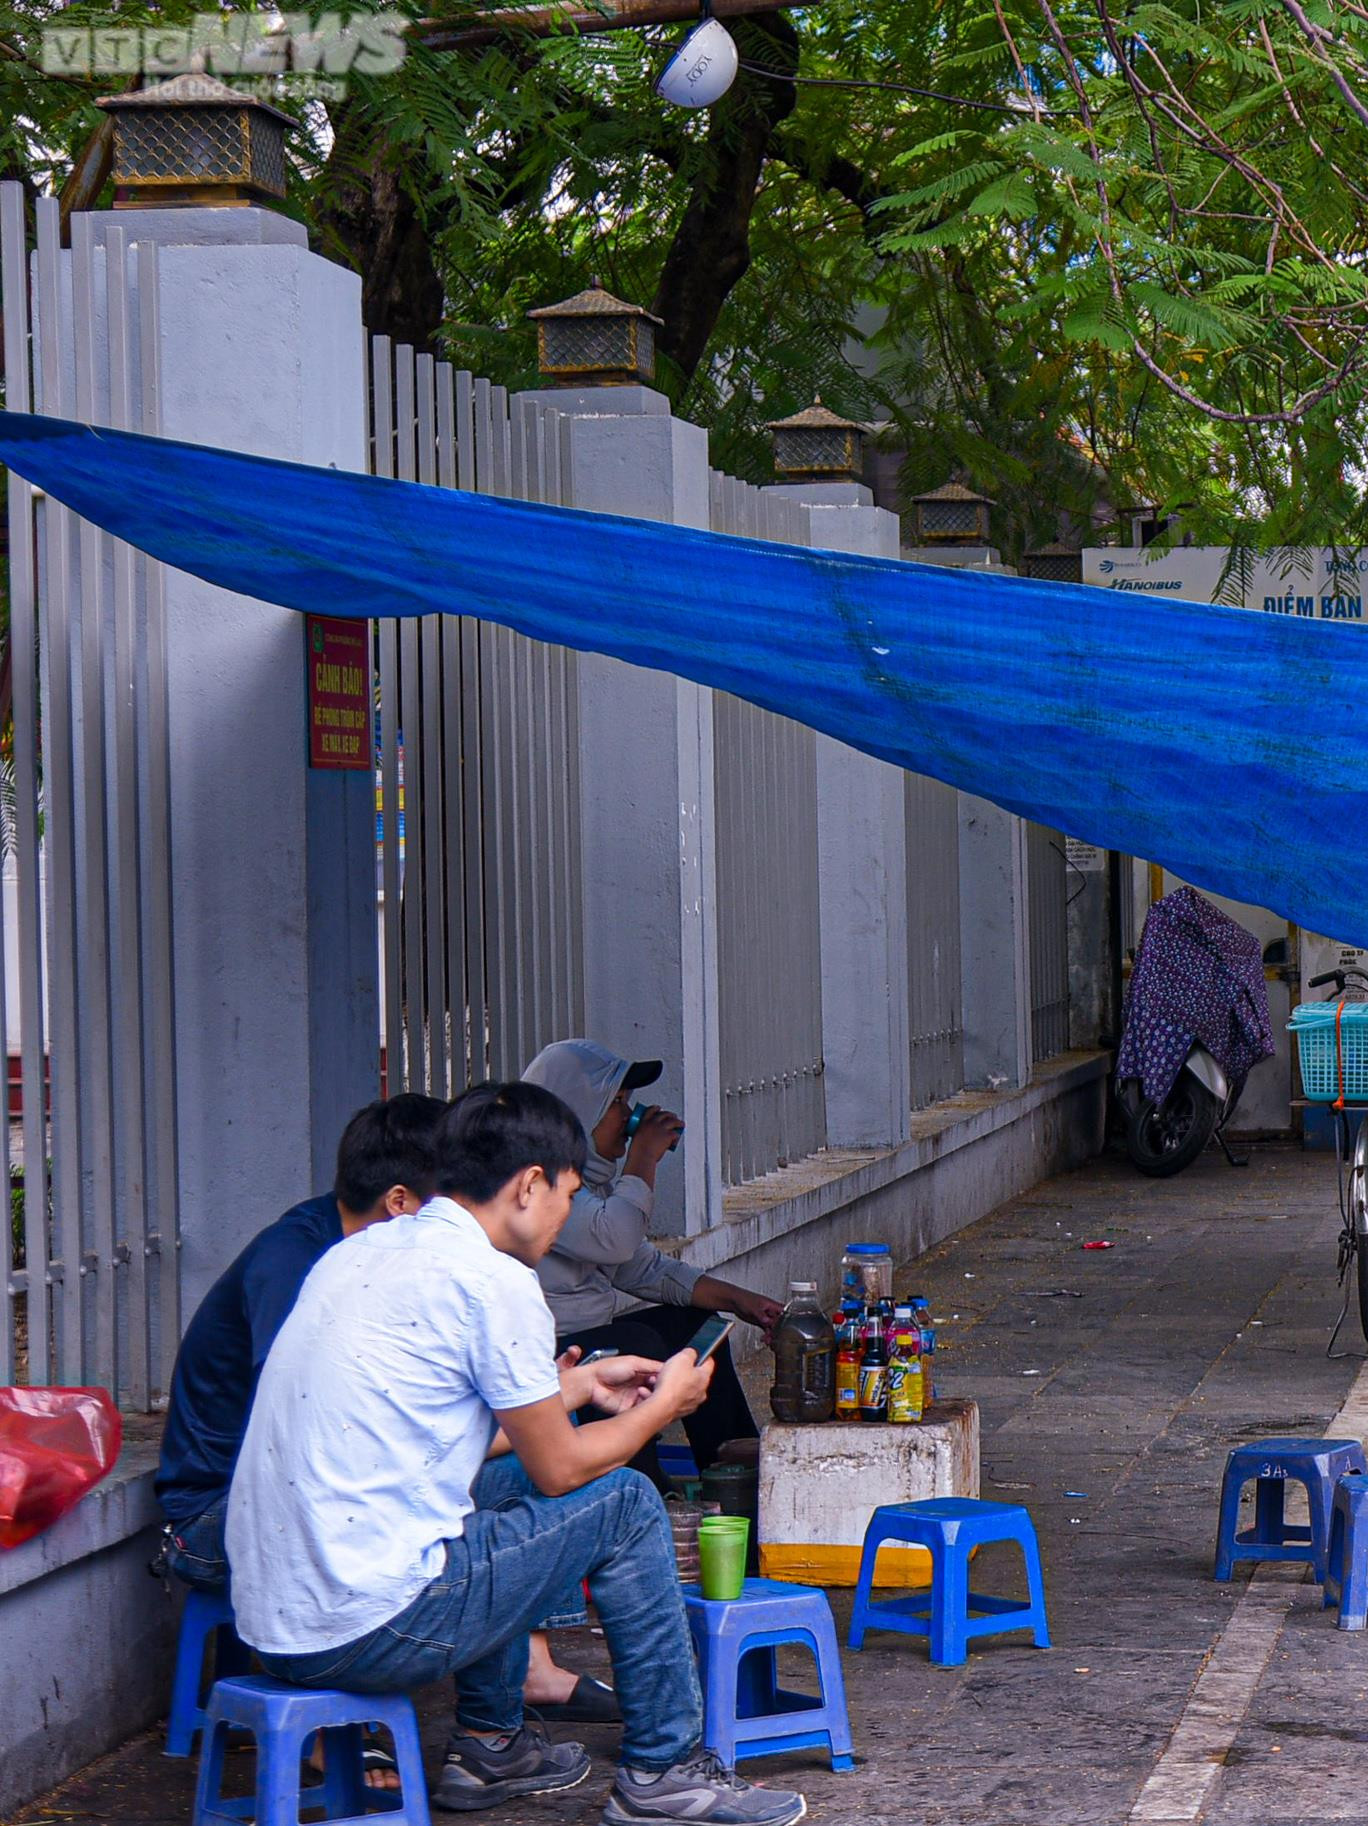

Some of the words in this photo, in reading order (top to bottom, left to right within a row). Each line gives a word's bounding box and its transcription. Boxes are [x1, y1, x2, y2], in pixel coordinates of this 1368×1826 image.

[686, 56, 712, 87] YODY
[1107, 578, 1182, 590] HANOIBUS
[316, 653, 340, 693] CẢNH
